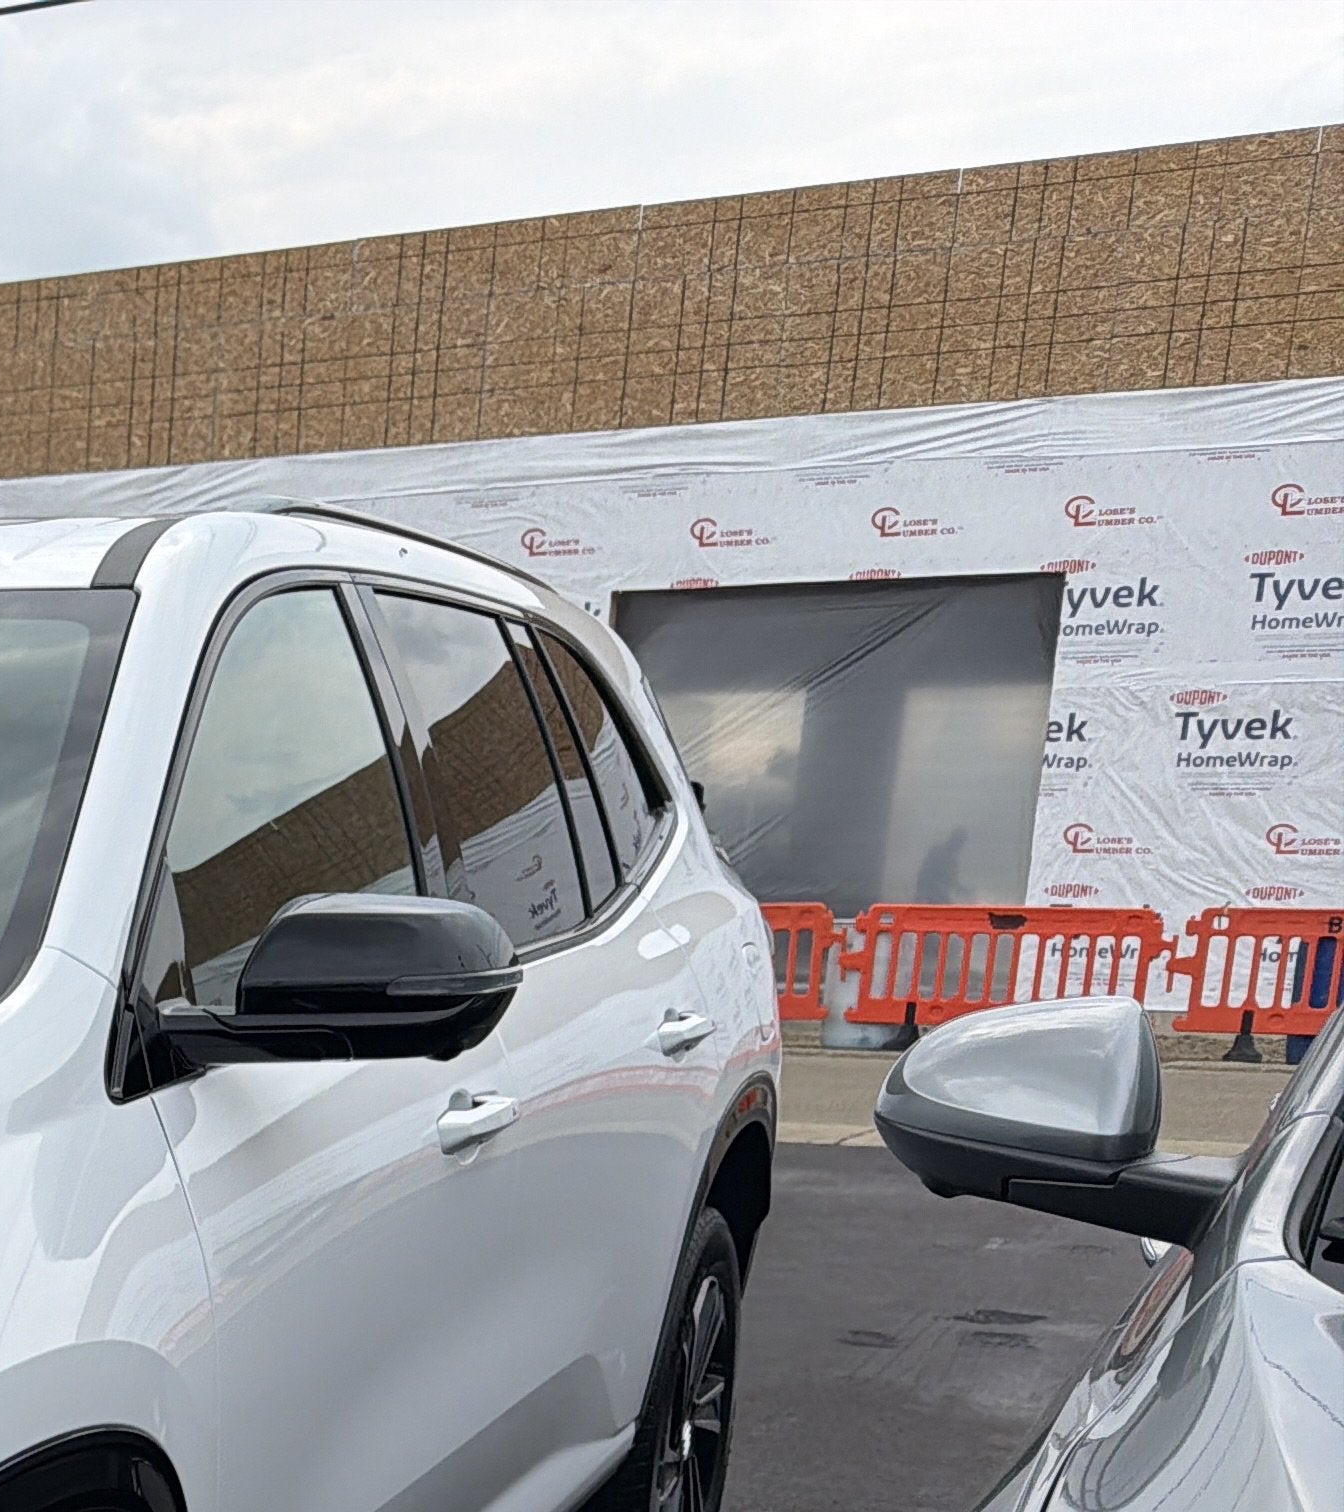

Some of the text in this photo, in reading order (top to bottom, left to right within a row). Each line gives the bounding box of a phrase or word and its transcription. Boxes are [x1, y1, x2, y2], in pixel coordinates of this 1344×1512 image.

[1252, 550, 1298, 565] DUPONT
[1064, 577, 1160, 618] yvek
[1250, 572, 1344, 611] Tyve
[1062, 619, 1160, 637] omeWrap
[1251, 612, 1344, 631] HomeWr
[1176, 689, 1221, 705] DUPONT
[1175, 709, 1294, 749] Tyvek
[1176, 751, 1293, 770] HomeWrap
[1050, 884, 1093, 898] DUPONT
[1252, 886, 1298, 900] DUPONT
